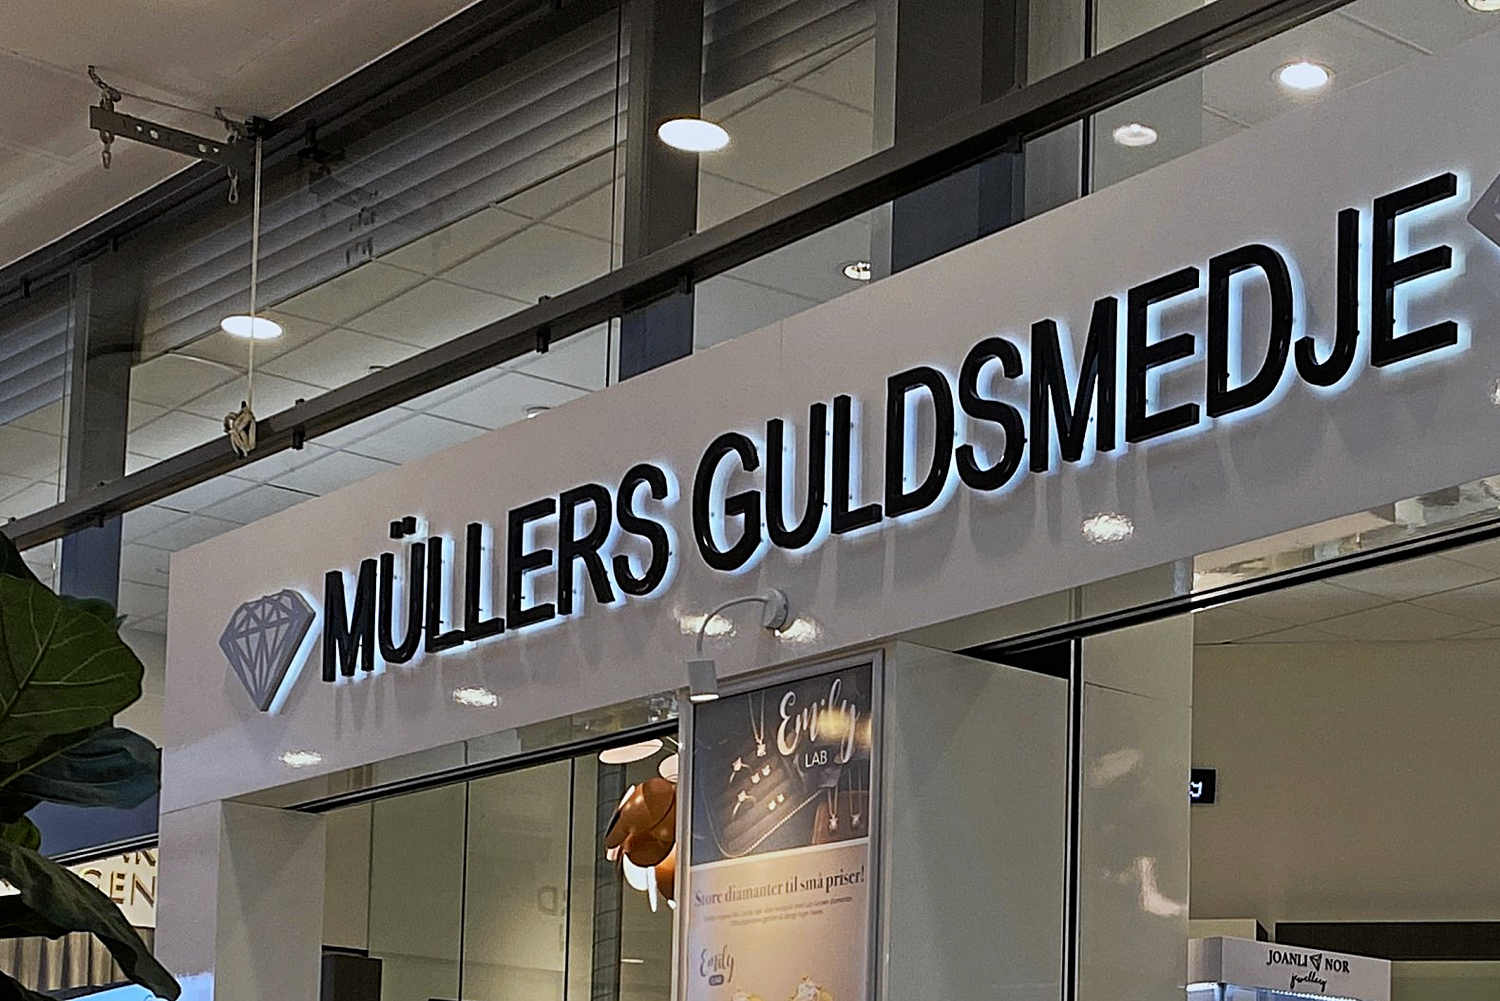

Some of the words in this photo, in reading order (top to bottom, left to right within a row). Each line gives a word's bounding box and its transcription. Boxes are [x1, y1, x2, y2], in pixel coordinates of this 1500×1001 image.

[321, 462, 668, 682] MÜLLERS
[691, 171, 1459, 571] GULDSMEDJE
[776, 678, 861, 764] Emily
[804, 750, 829, 768] LAB
[80, 868, 157, 909] EN
[694, 889, 722, 908] Store
[724, 881, 784, 903] diamanter
[785, 875, 798, 894] til
[799, 872, 823, 892] små
[825, 865, 866, 894] priser!
[1266, 949, 1308, 967] JOANLI
[1324, 957, 1350, 973] NOR
